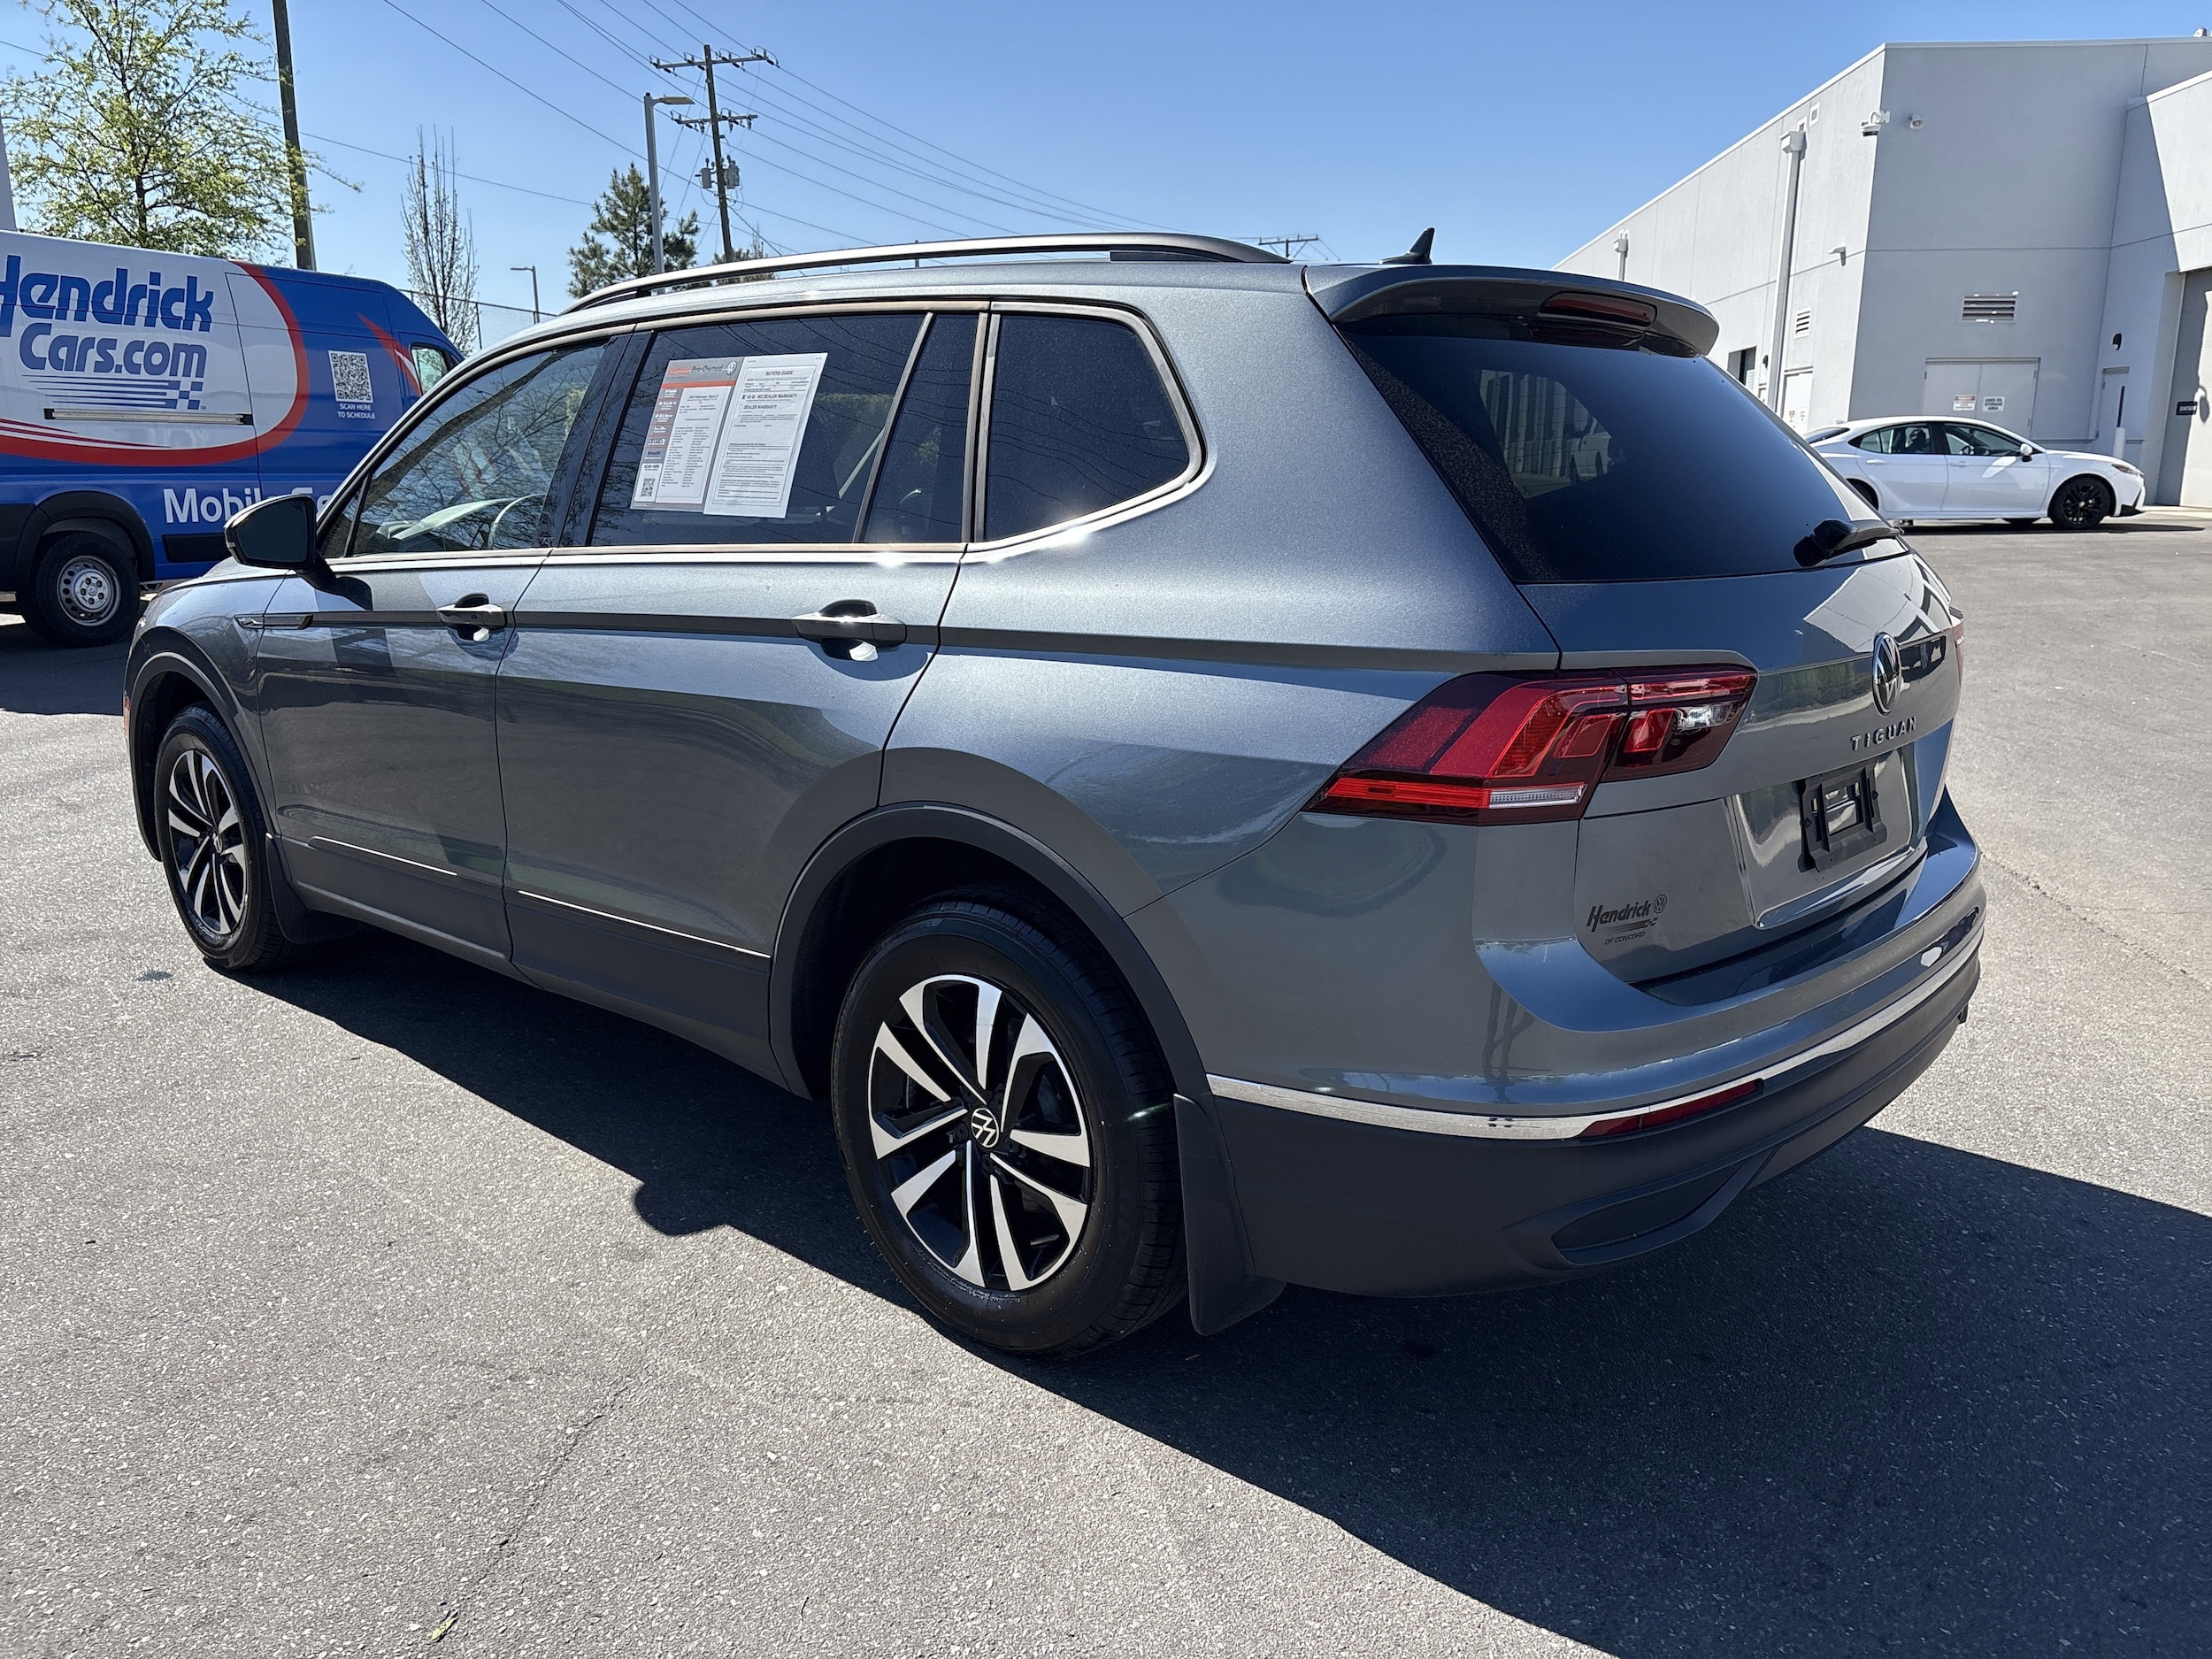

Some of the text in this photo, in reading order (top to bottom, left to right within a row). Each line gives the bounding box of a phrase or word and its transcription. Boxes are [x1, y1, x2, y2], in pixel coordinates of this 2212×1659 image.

[19, 322, 208, 379] Cars.com
[691, 364, 723, 373] Pre-Owned
[1849, 716, 1917, 752] TIGUAN
[1586, 900, 1652, 933] Hendrick
[1614, 931, 1647, 943] CONCORD
